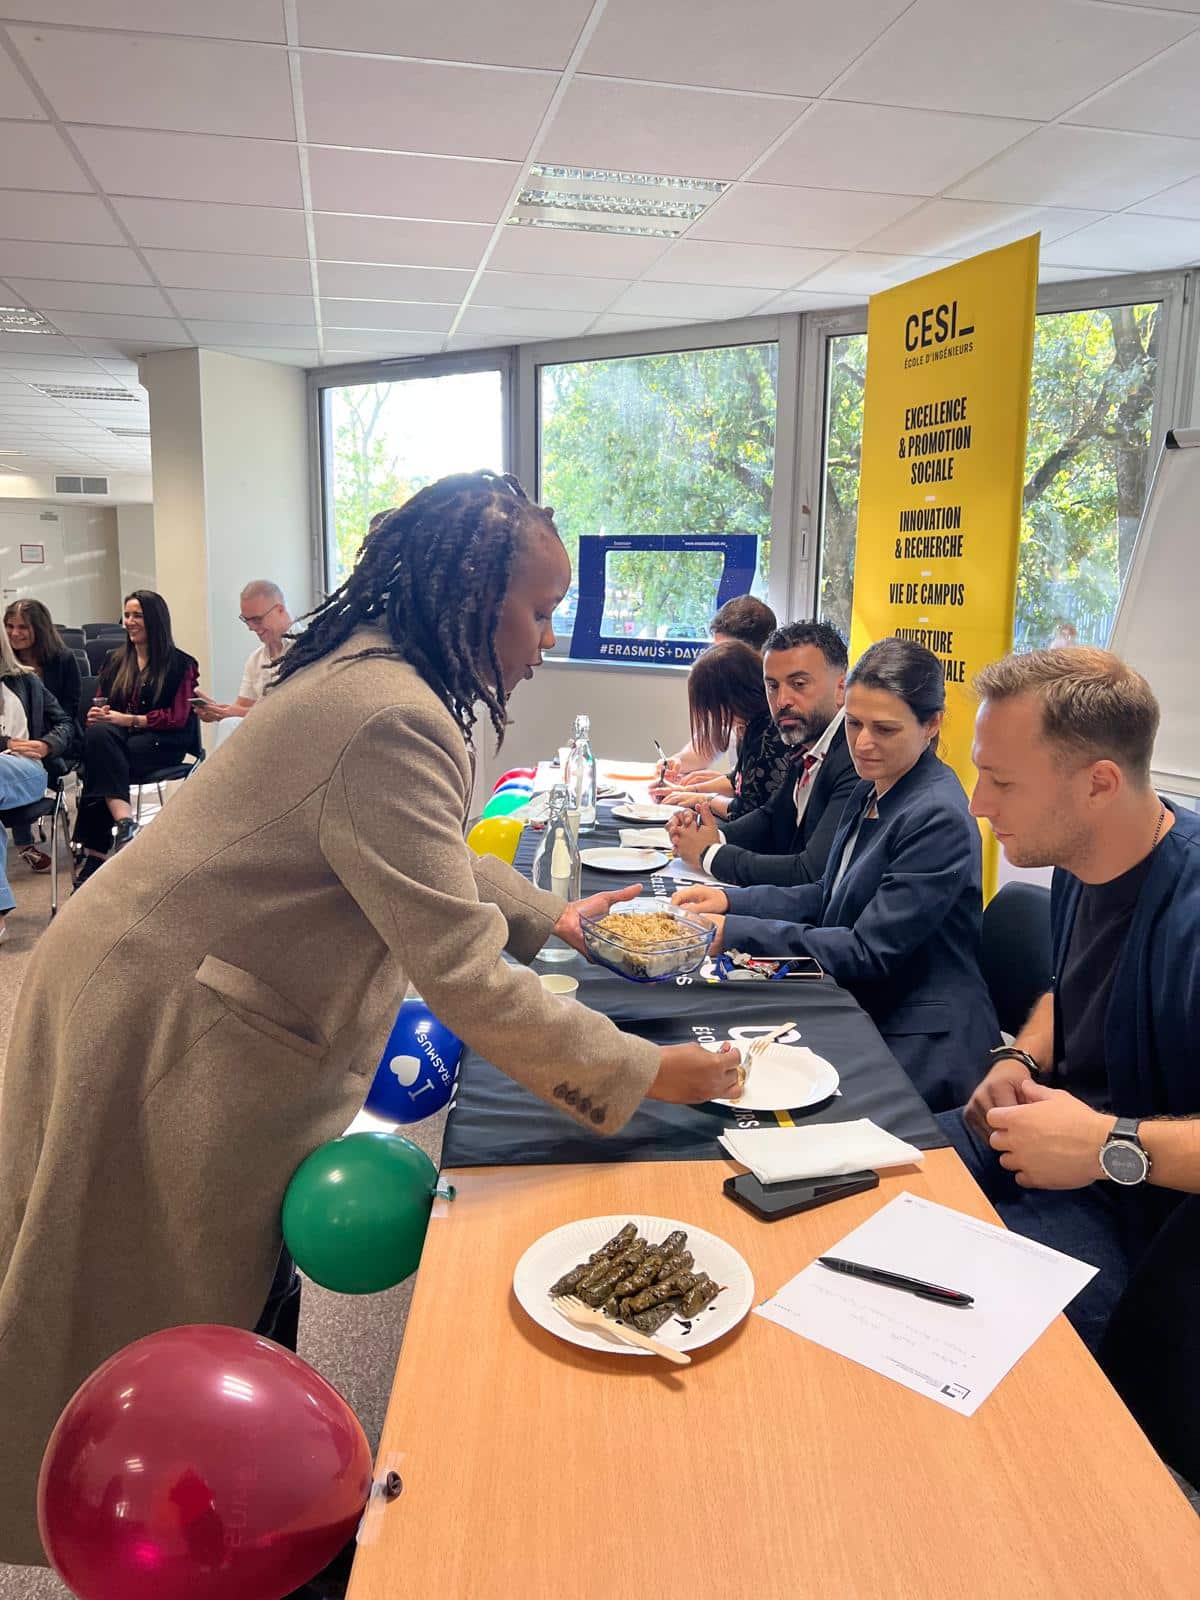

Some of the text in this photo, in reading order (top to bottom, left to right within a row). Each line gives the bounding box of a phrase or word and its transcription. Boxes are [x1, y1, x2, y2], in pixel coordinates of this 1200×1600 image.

[904, 341, 974, 369] ÉCOLE D'INGÉNIEURS
[905, 396, 968, 431] EXCELLENCE
[898, 425, 972, 459] & PROMOTION
[911, 457, 954, 485] SOCIALE
[900, 506, 961, 532] INNOVATION
[895, 534, 964, 559] & RECHERCHE
[889, 583, 965, 606] VIE DE CAMPUS
[408, 1078, 435, 1102] I
